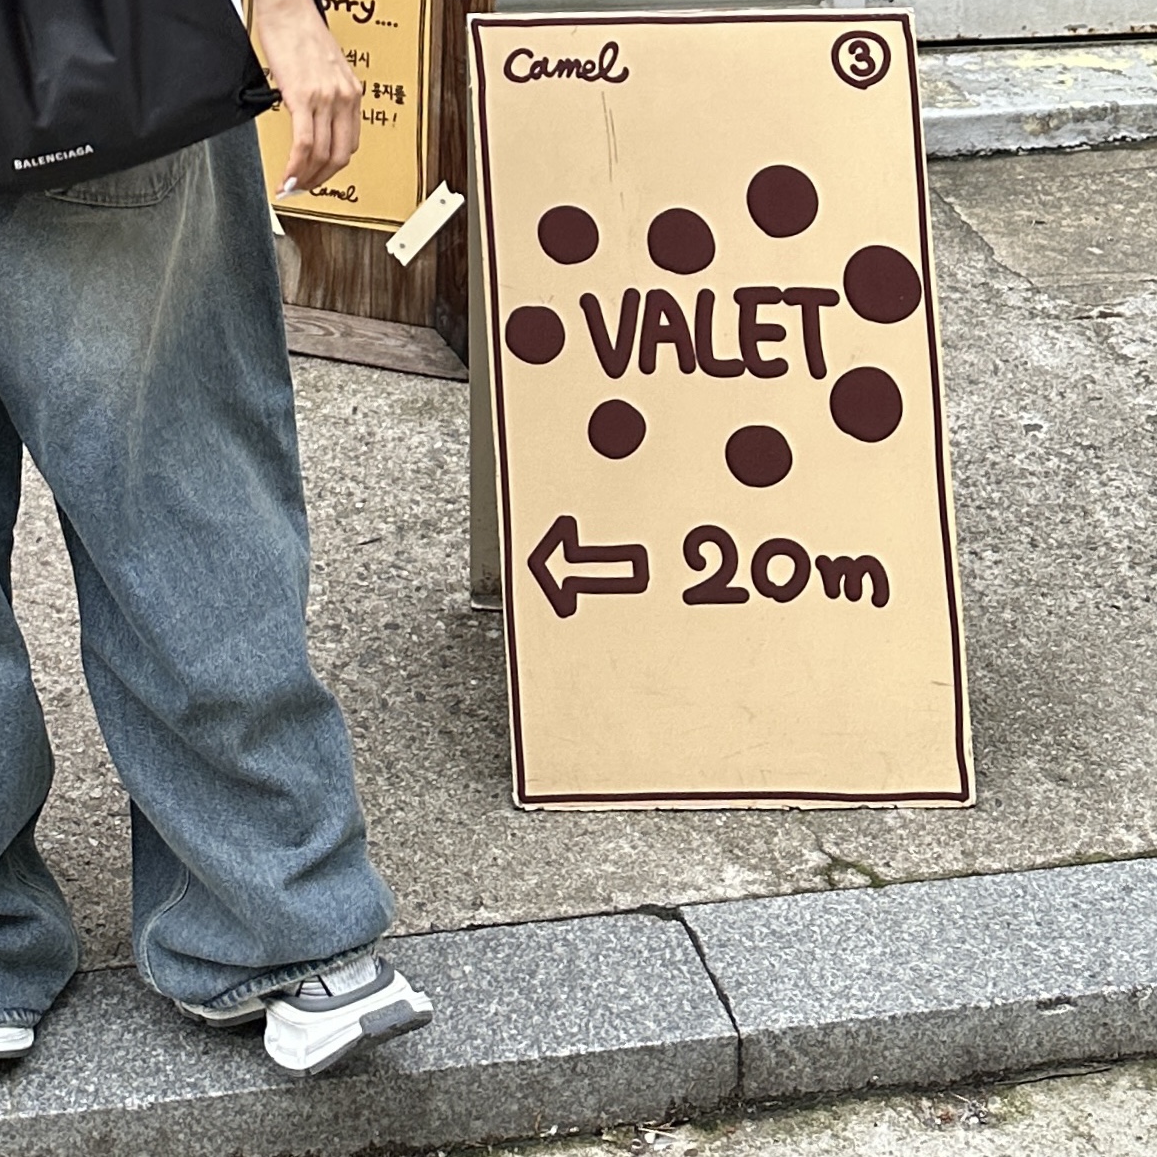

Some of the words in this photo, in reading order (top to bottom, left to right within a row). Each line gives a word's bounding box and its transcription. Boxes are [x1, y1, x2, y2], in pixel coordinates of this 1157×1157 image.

[503, 40, 630, 85] Camel
[13, 144, 95, 170] BALENCIAGA
[579, 286, 841, 380] VALET
[681, 524, 890, 609] 20m
